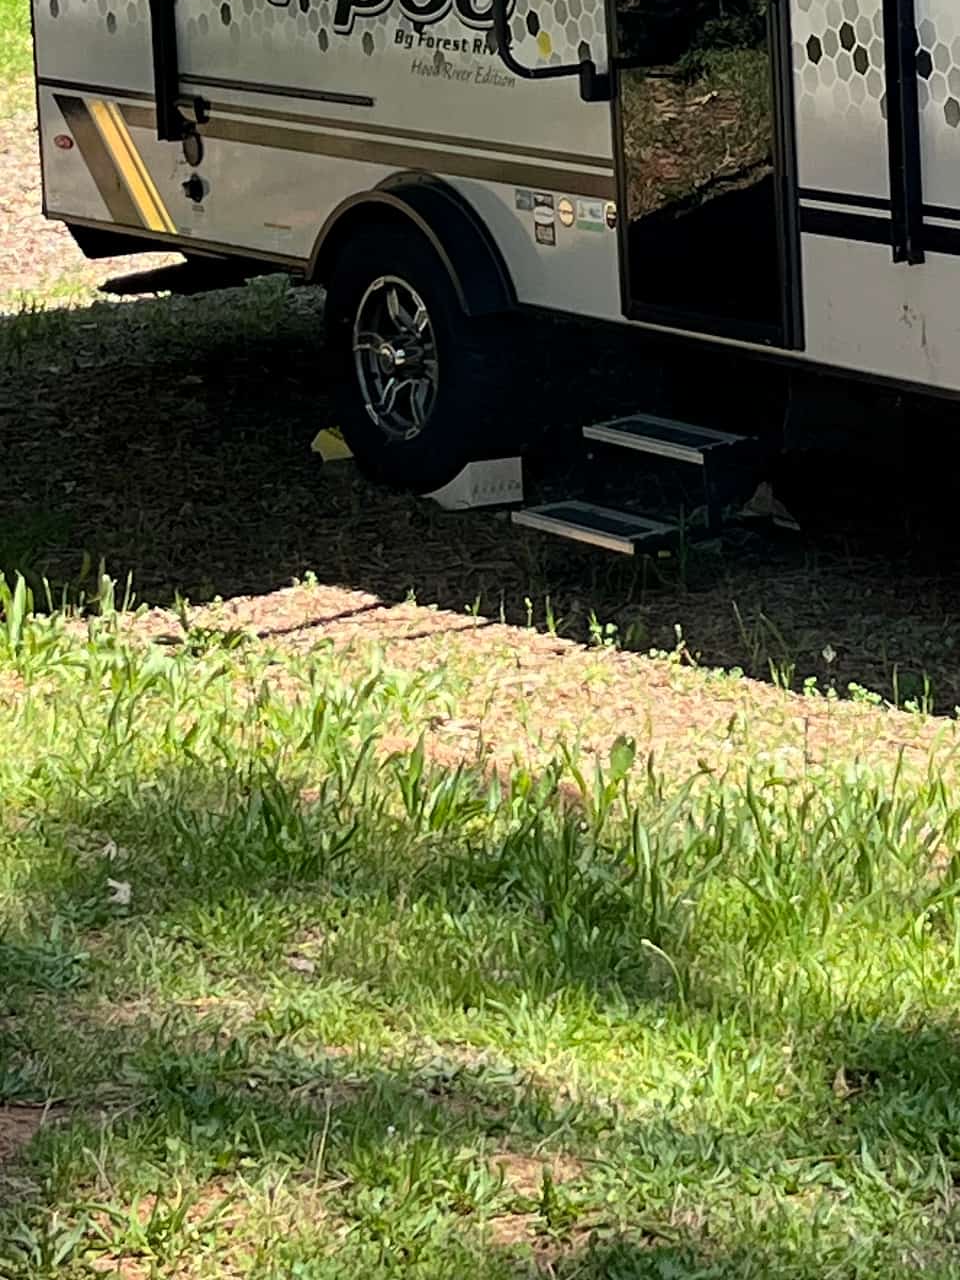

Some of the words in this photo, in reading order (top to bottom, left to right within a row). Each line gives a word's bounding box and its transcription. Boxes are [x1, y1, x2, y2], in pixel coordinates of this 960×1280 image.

[394, 29, 414, 50] By
[418, 31, 470, 54] Forest
[443, 61, 473, 81] River
[474, 64, 516, 88] Edition
